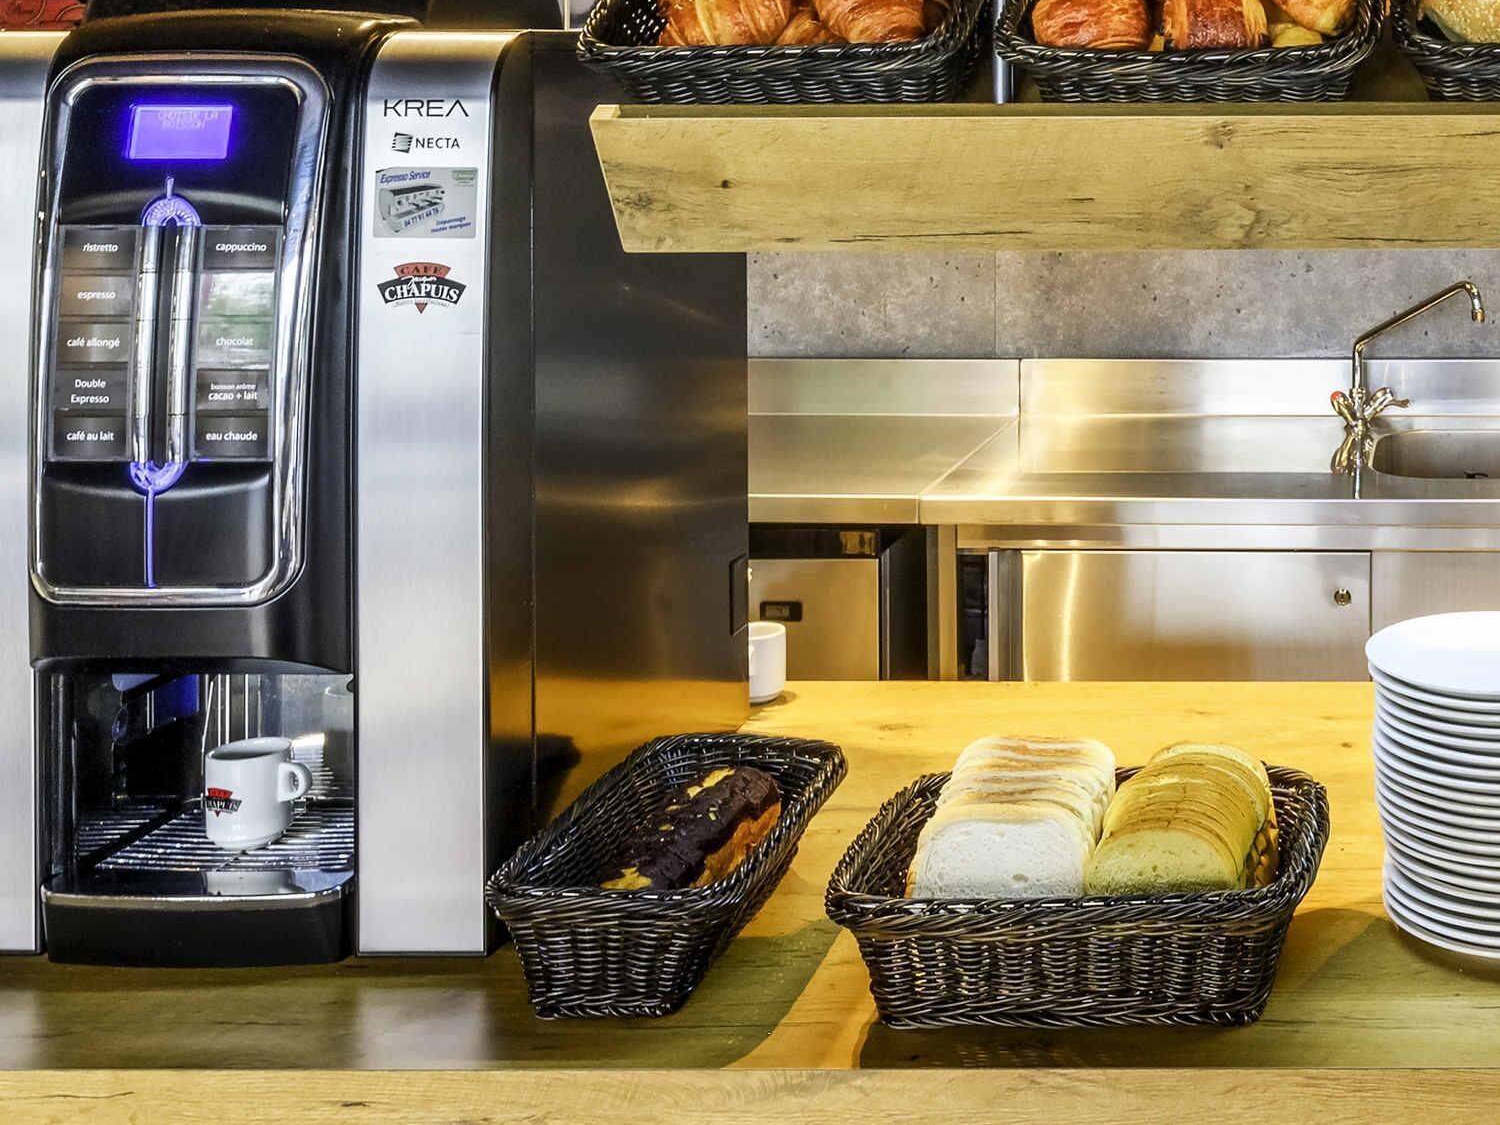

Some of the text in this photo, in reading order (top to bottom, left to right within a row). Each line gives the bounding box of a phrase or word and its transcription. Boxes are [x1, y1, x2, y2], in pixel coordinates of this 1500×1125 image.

[383, 99, 469, 117] KREA
[415, 137, 460, 149] NECTA
[82, 242, 118, 252] ristretto
[215, 242, 267, 253] cappuccino
[77, 291, 116, 301] espresso
[384, 282, 459, 302] CHAPUIS
[66, 337, 121, 349] café allongé
[215, 337, 254, 347] chocolat
[75, 379, 106, 389] Double
[70, 394, 110, 405] Expresso
[208, 392, 234, 401] cacao
[243, 390, 258, 401] lait
[66, 430, 115, 441] café au lait
[205, 431, 258, 441] eau chaude
